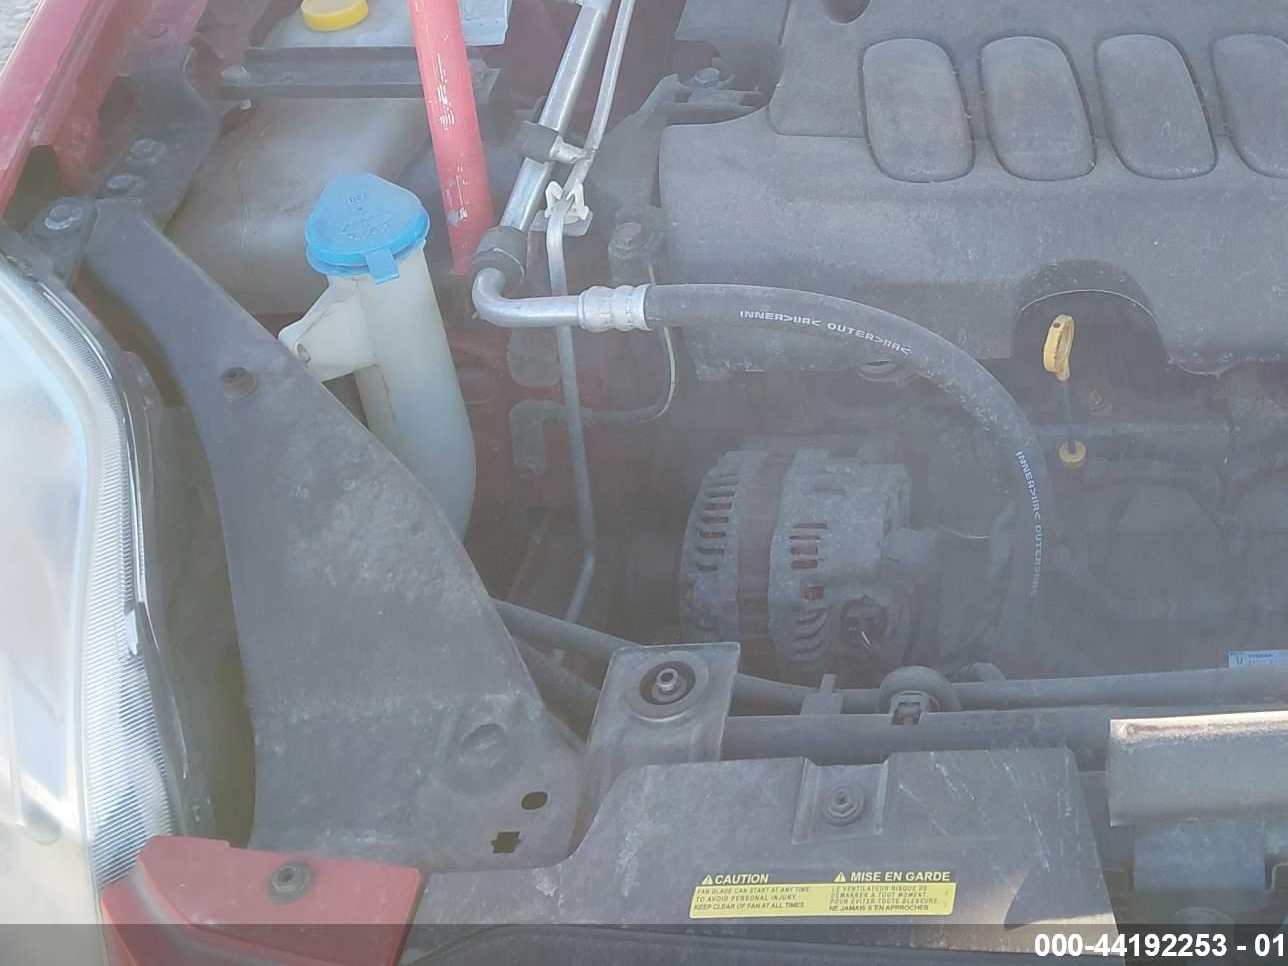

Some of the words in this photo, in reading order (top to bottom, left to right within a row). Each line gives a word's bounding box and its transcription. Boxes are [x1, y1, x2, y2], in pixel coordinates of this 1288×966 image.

[715, 873, 769, 884] CAUTION
[850, 871, 882, 882] MISE
[884, 871, 902, 882] EN
[905, 871, 951, 881] GARDE
